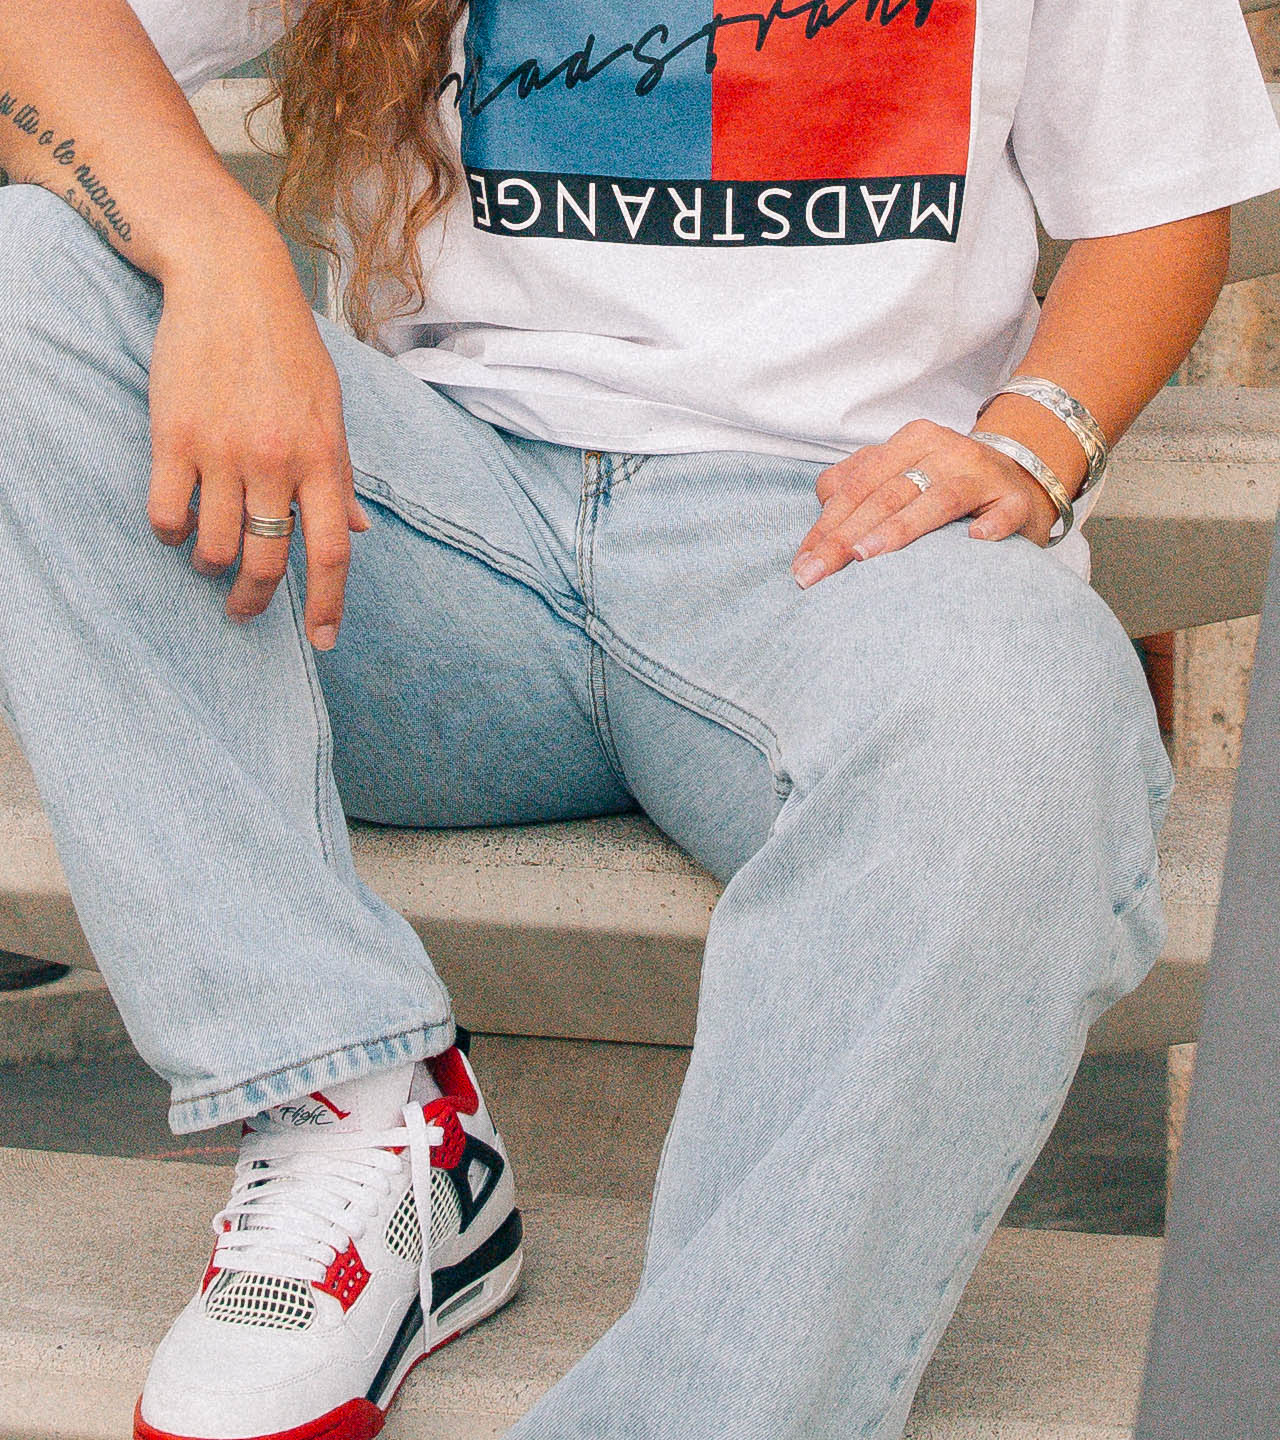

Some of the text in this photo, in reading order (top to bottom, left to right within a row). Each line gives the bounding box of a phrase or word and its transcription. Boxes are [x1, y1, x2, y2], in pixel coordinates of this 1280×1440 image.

[53, 138, 75, 165] le
[470, 173, 957, 241] MADSTRANGE
[279, 1104, 333, 1126] Flight
